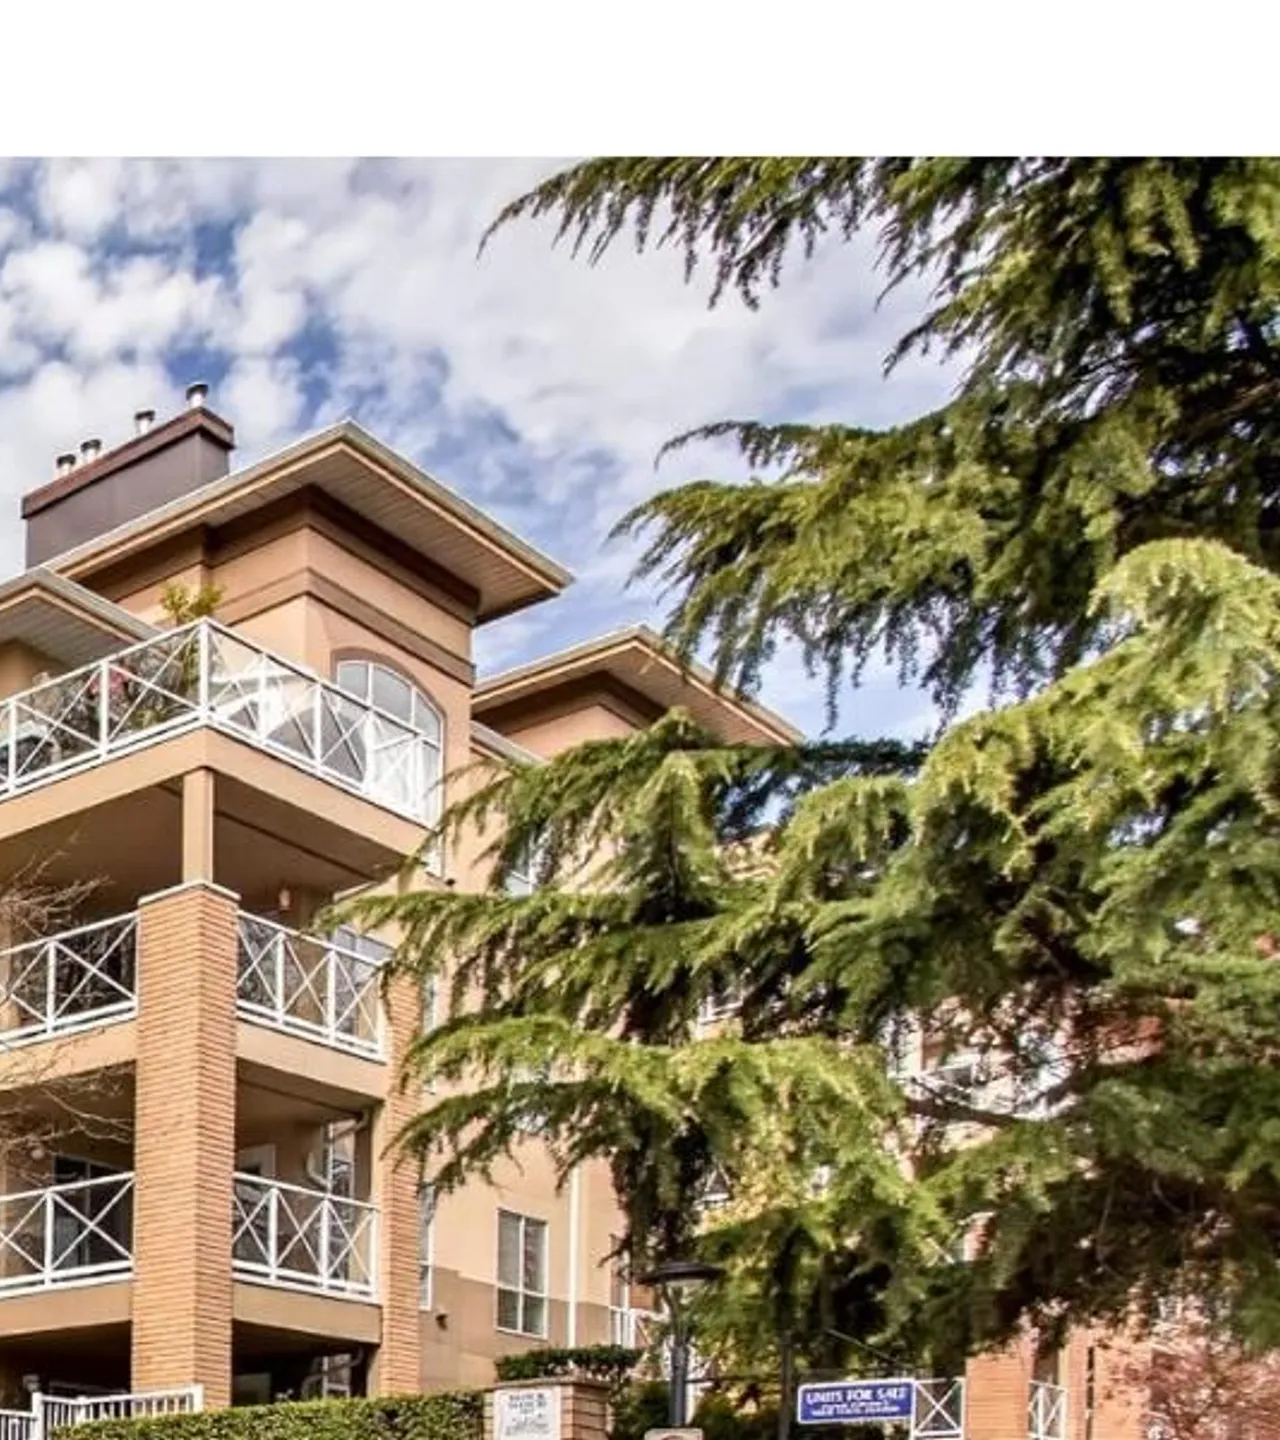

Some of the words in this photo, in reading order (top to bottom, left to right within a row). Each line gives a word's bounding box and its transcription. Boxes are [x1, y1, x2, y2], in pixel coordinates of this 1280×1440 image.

[806, 1390, 842, 1405] UNITS
[847, 1388, 872, 1401] FOR
[878, 1386, 907, 1400] SALE
